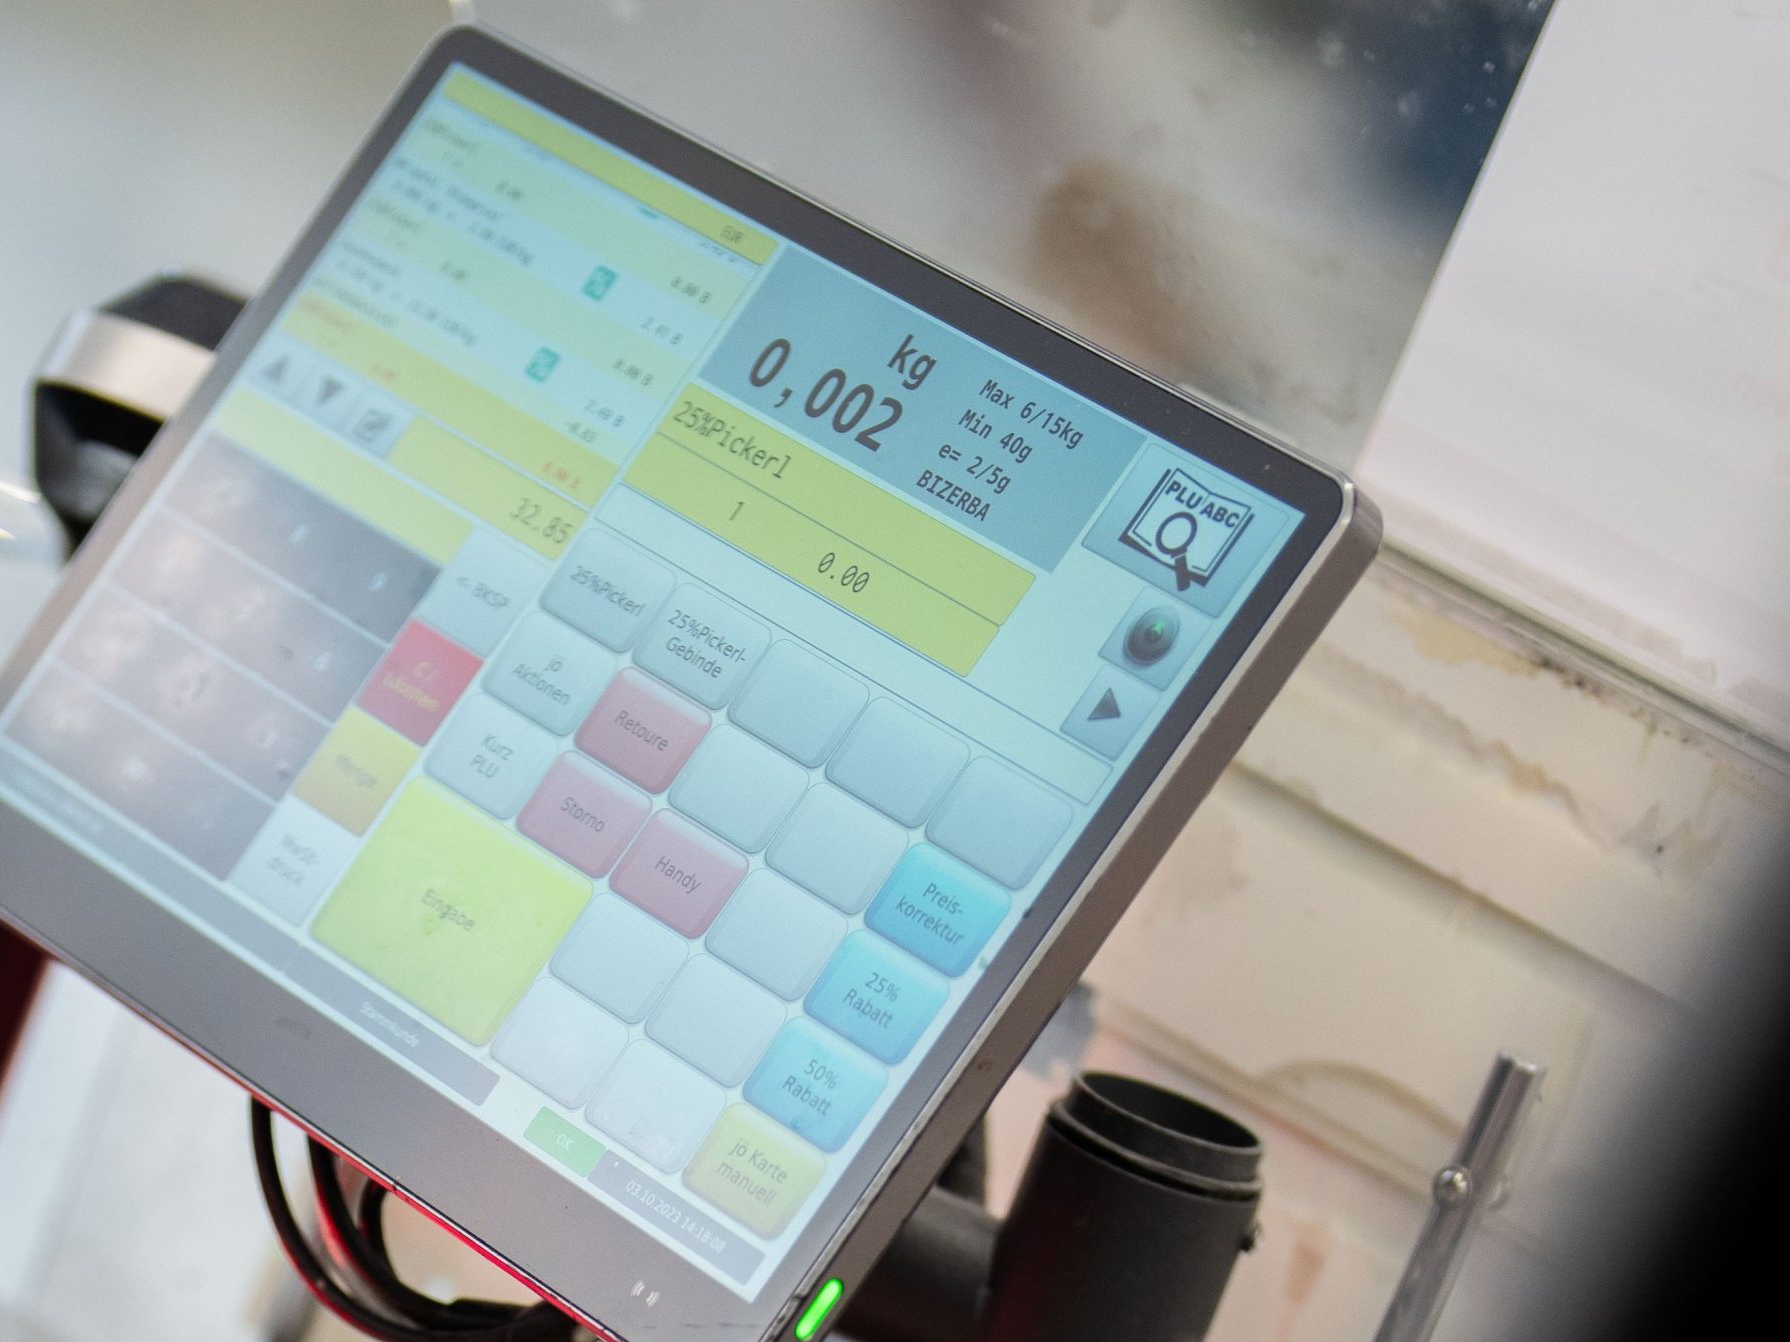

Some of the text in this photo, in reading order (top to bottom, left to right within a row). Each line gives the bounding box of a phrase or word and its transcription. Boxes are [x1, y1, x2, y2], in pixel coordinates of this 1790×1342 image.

[886, 334, 937, 391] kg
[748, 337, 903, 452] 0,002
[979, 379, 1084, 450] Max 6/15kg
[672, 400, 793, 480] 25%Pickerl
[958, 408, 1033, 463] Min 40g
[938, 443, 1012, 495] e= 2/5g
[916, 469, 991, 522] BIZERBA
[1163, 479, 1240, 529] PLU ABC
[510, 497, 573, 544] 32.85
[817, 552, 870, 593] 0.00
[665, 636, 723, 679] Gebinde
[511, 662, 571, 706] Aktionen
[480, 732, 515, 762] Kurz
[614, 709, 669, 751] Retoure
[469, 753, 501, 779] PLU
[559, 796, 606, 833] Storno
[654, 854, 703, 895] Handy
[421, 888, 475, 932] Eingabe
[895, 894, 965, 946] korrektur
[922, 881, 965, 916] Preis-
[843, 987, 894, 1029] Rabatt
[864, 971, 900, 1002] 25%
[803, 1058, 840, 1089] 50%
[781, 1075, 833, 1116] Rabatt
[716, 1160, 777, 1208] manuell
[747, 1149, 789, 1184] Karte
